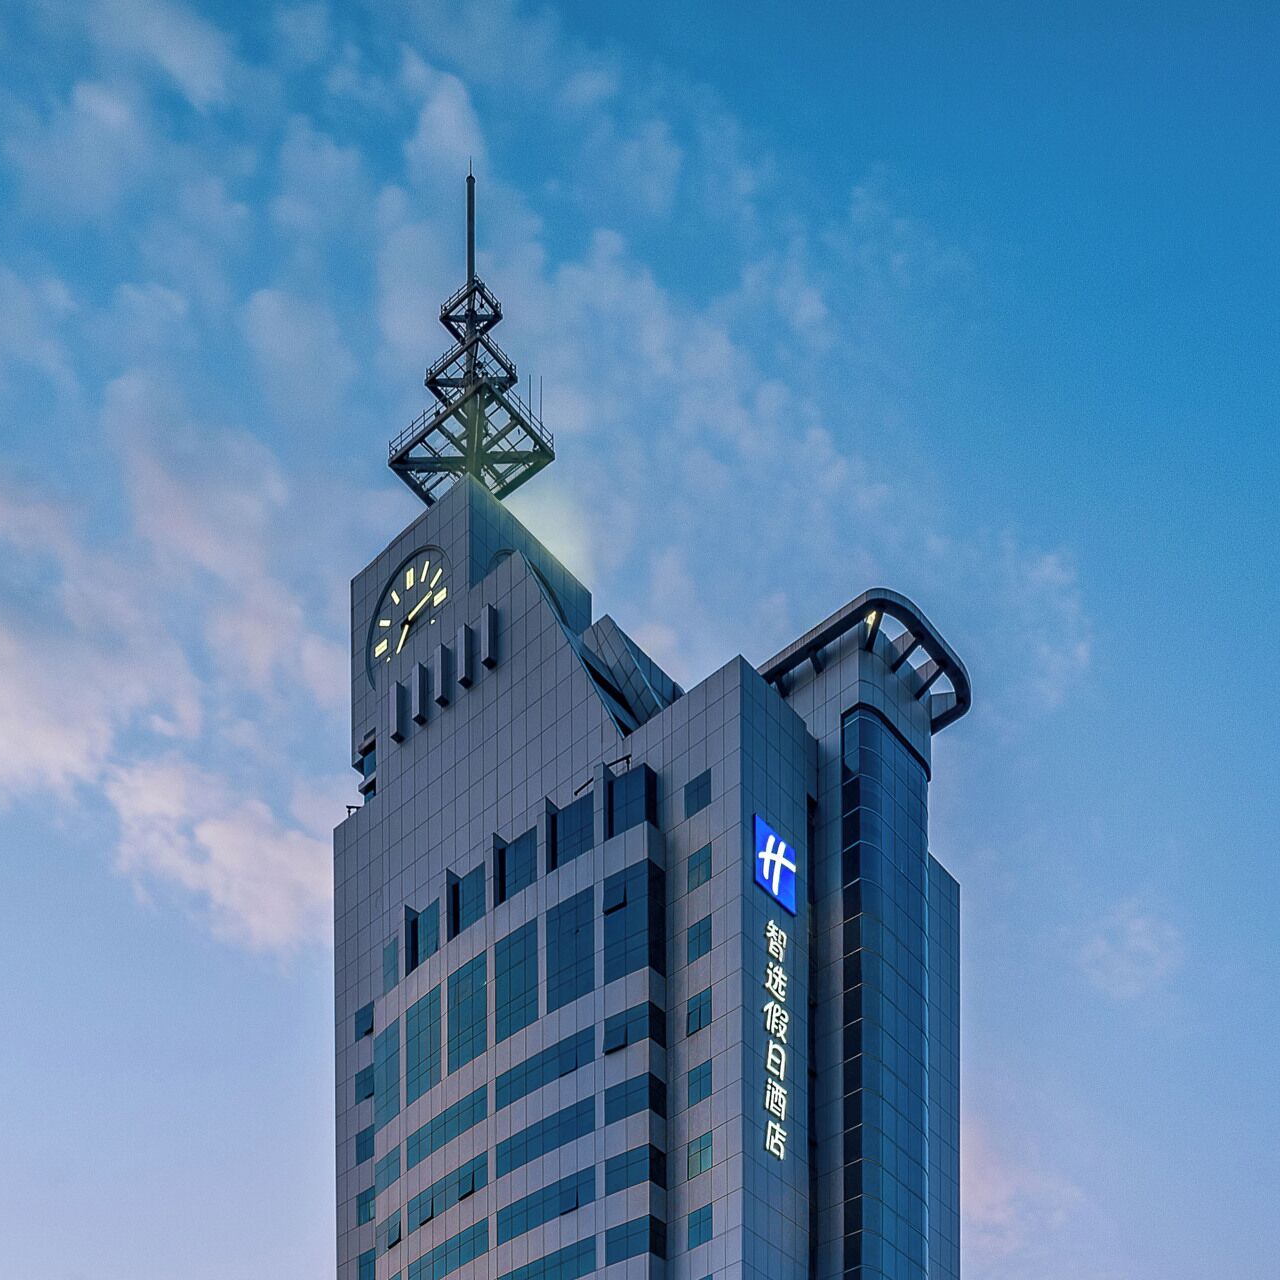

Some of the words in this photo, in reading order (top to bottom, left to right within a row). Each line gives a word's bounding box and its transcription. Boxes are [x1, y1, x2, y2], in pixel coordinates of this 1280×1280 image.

[763, 919, 790, 1161] 智选假日酒店
